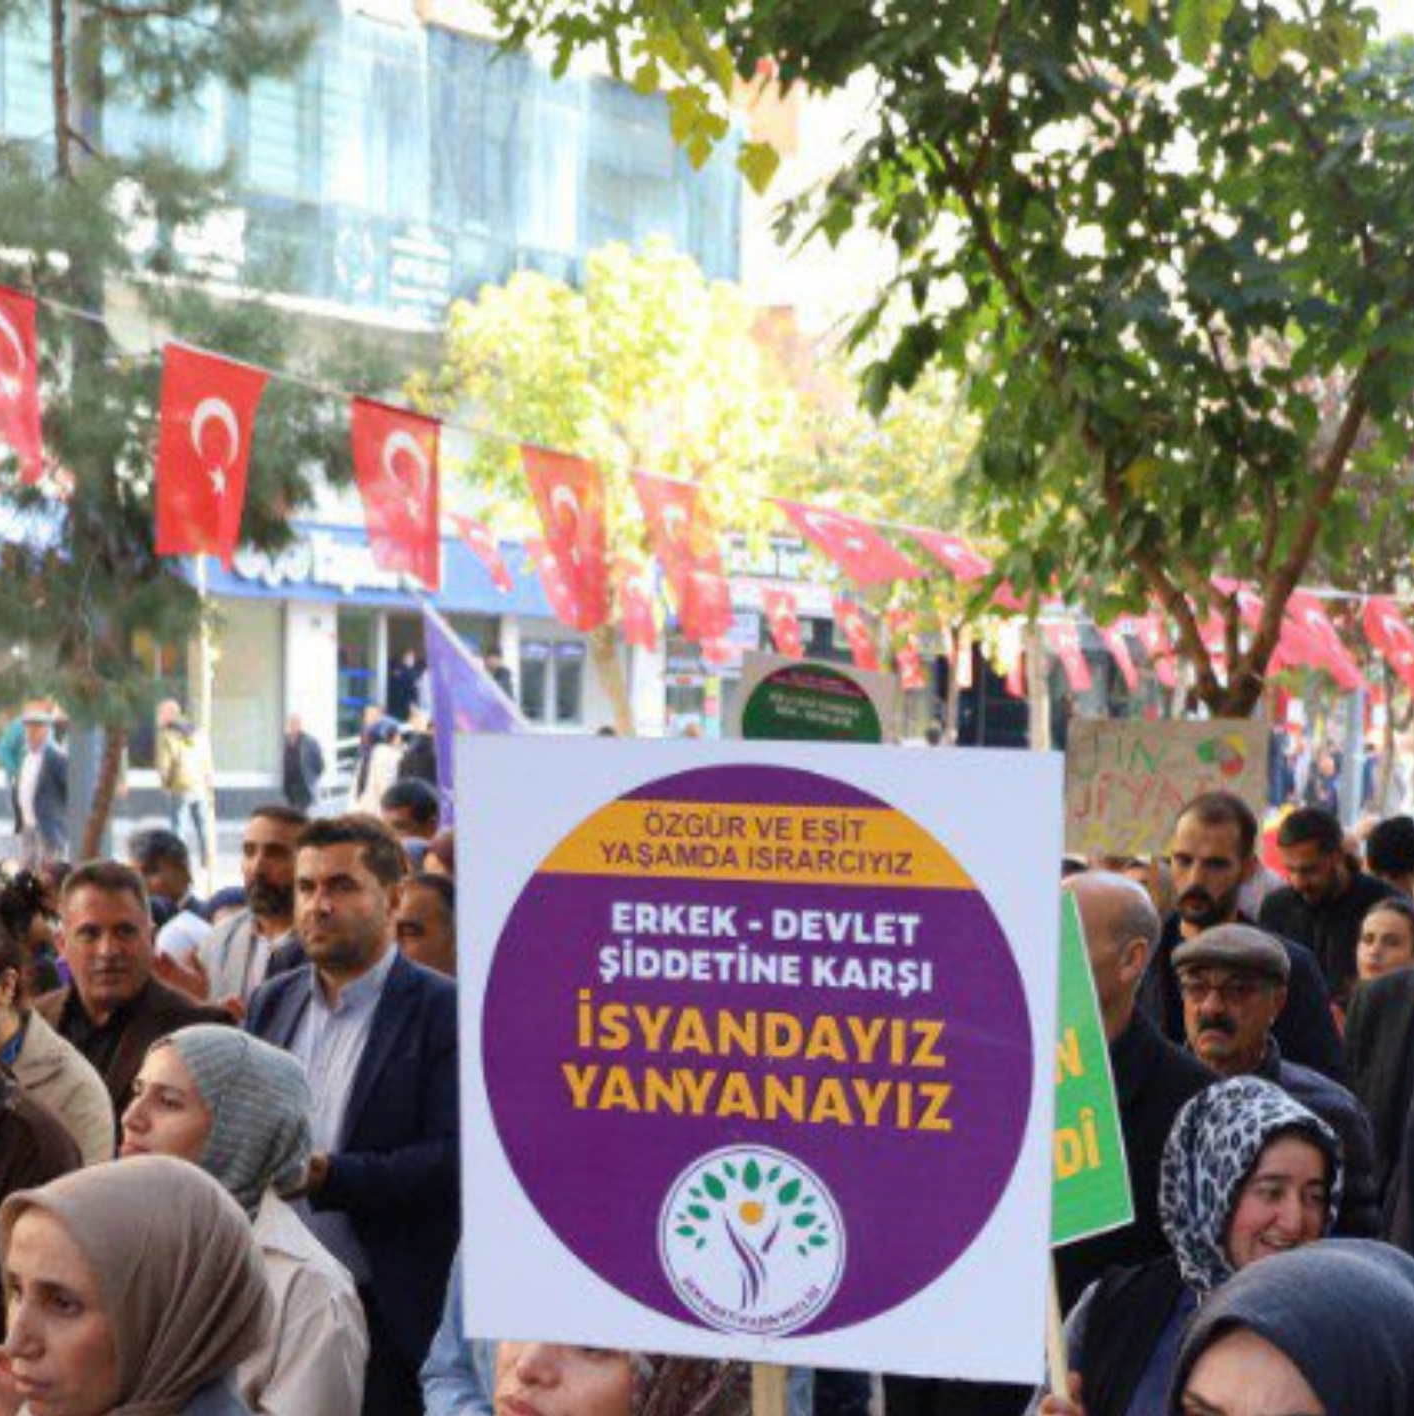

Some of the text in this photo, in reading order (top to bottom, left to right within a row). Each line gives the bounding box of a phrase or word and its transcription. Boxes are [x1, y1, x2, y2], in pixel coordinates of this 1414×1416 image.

[643, 807, 865, 845] ÖZGÜR VE EŞİT
[600, 840, 740, 868] YAŞAMDA
[611, 903, 737, 937] ERKEK
[773, 910, 919, 945] DEVLET
[598, 940, 932, 996] ŞİDDETİNE KARŞI
[576, 989, 947, 1067] İSYANDAYIZ
[561, 1063, 952, 1131] YANYANAYIZ
